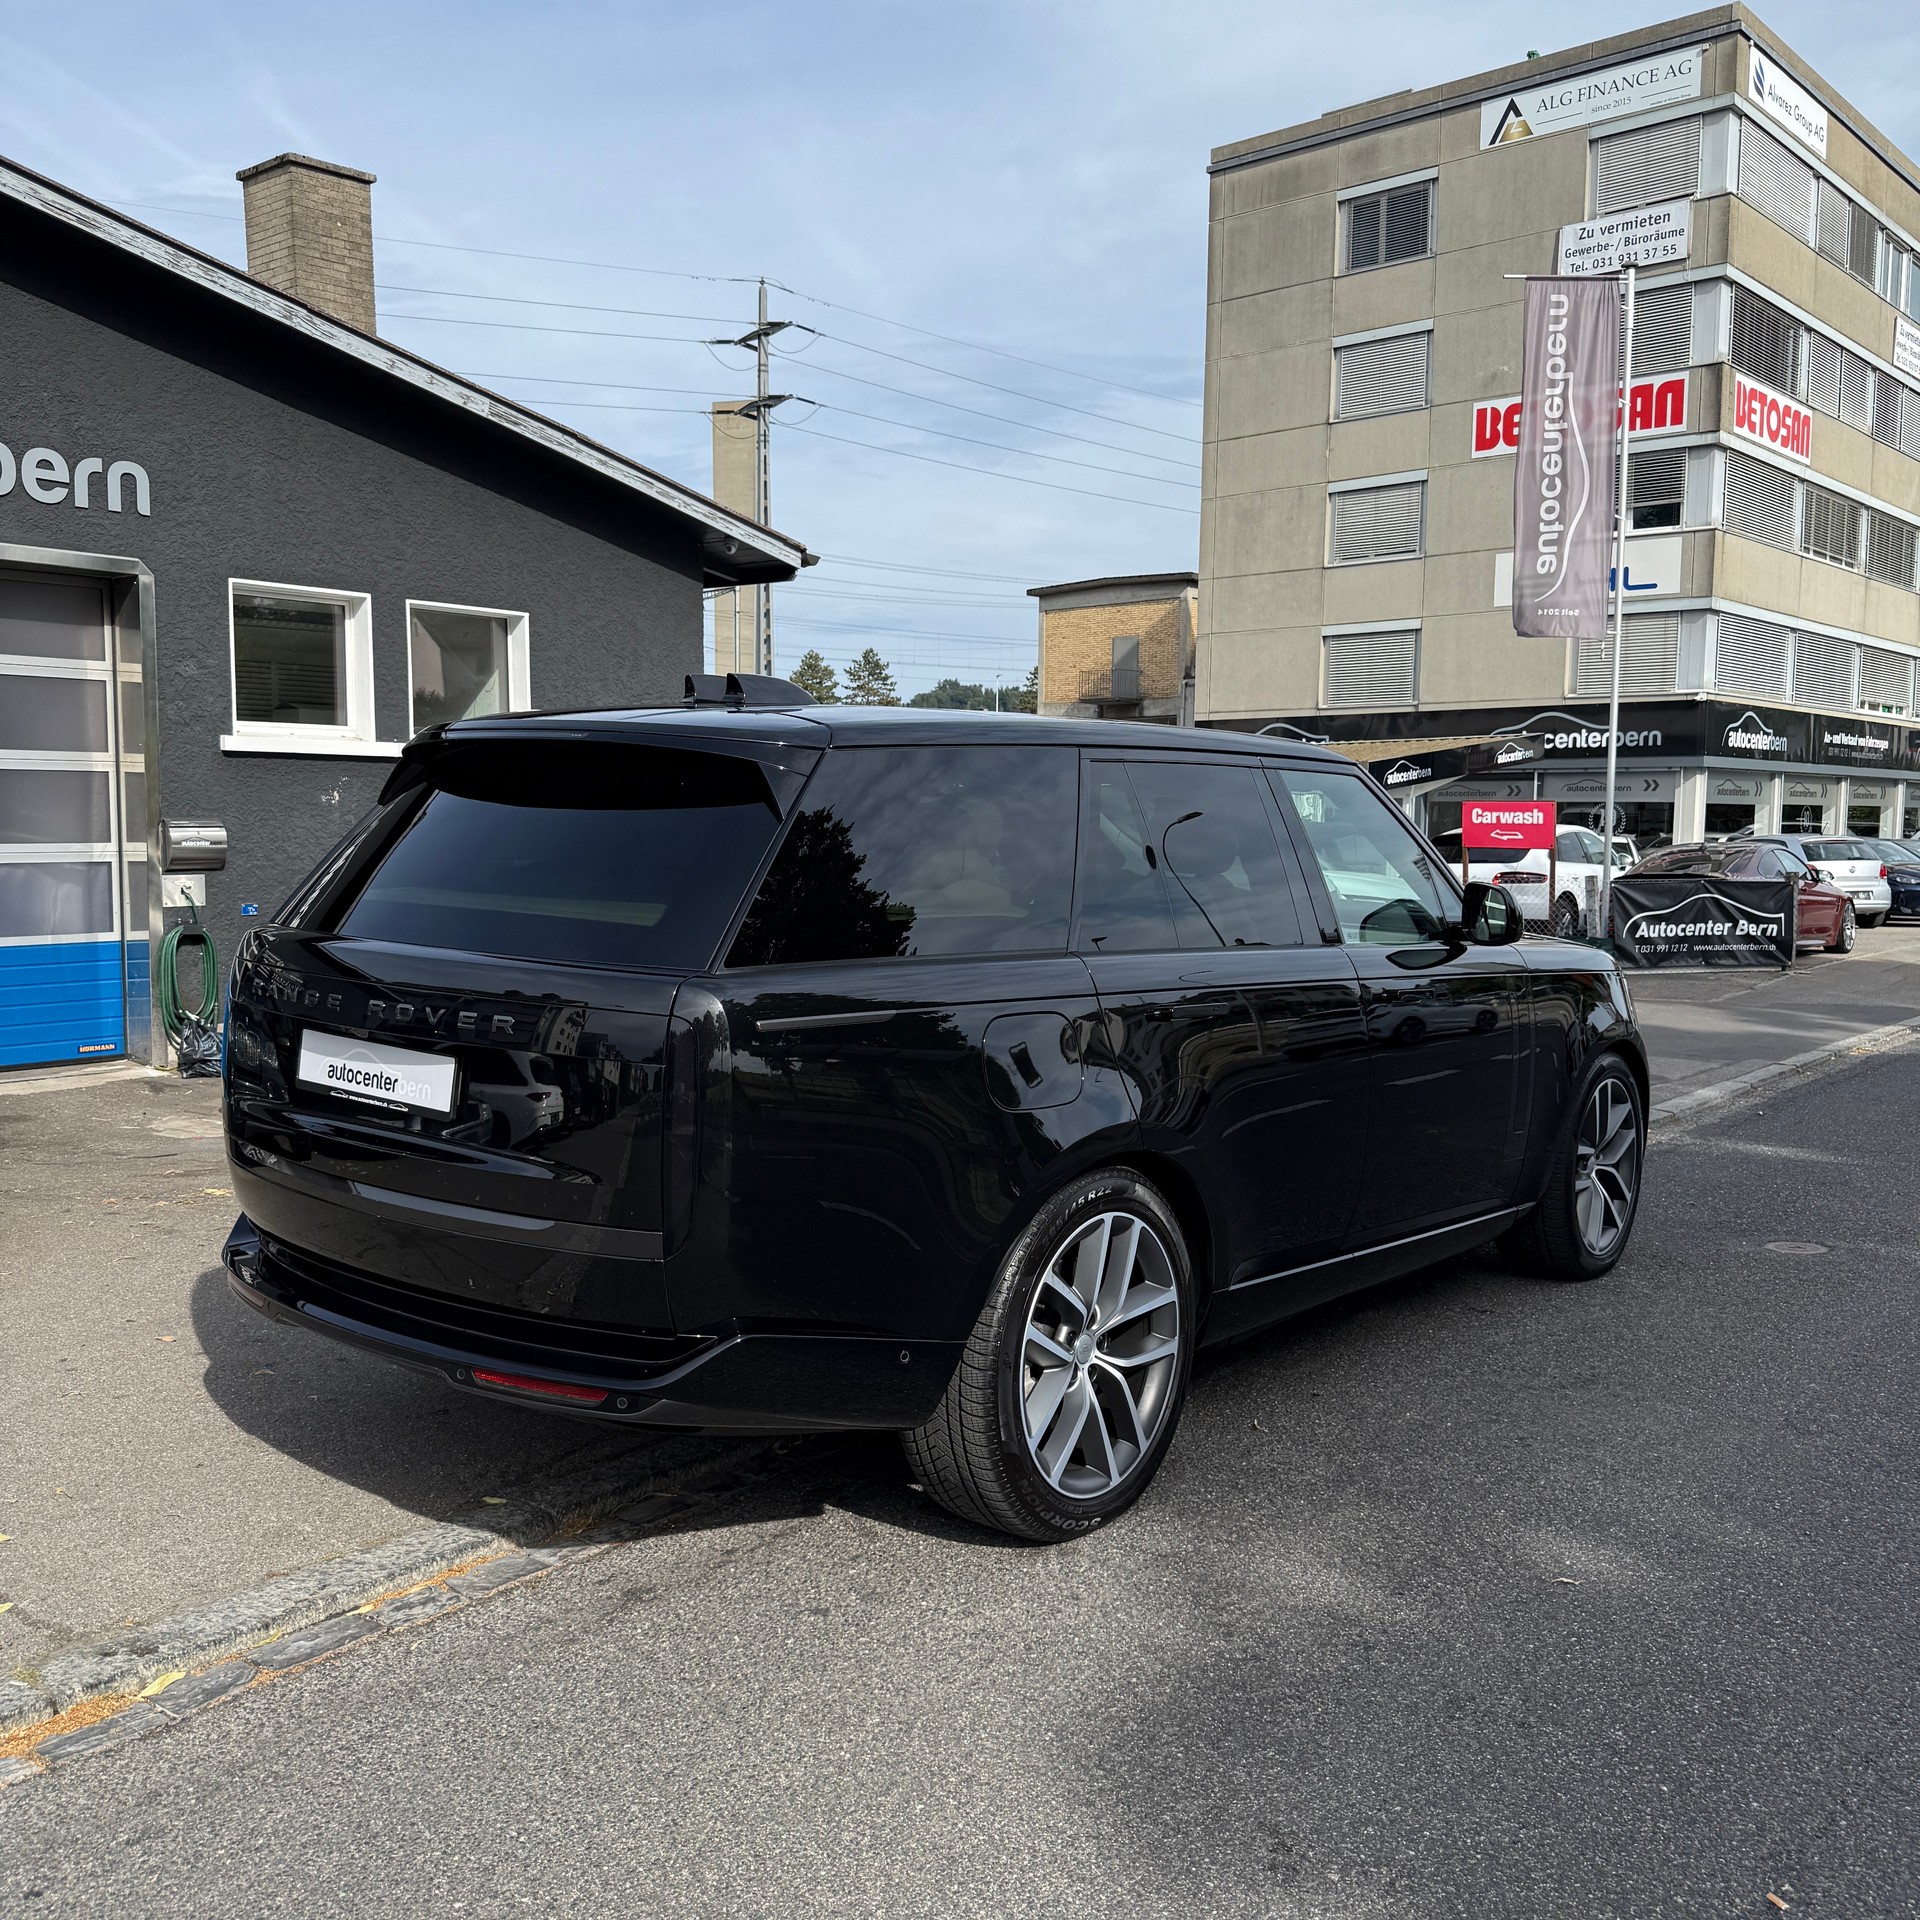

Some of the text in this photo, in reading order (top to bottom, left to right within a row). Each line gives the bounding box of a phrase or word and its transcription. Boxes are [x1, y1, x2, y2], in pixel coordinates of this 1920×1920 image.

[1536, 59, 1692, 113] ALG FINANCE AG
[1591, 96, 1632, 114] since 2015
[1767, 83, 1825, 142] Alvarez Group AG
[1578, 212, 1671, 241] Zu vermieten
[1624, 228, 1685, 247] Büroräume
[1570, 243, 1677, 273] Tel. 031 931 37 55
[1474, 378, 1686, 452] BEAN
[1735, 379, 1812, 459] BETOSAN
[1728, 729, 1788, 752] autocenterbern
[1387, 768, 1432, 785] autocenterbern
[1437, 788, 1497, 797] autocenterbern
[1566, 784, 1632, 793] autocenteern
[1471, 808, 1544, 825] Carwash
[1634, 919, 1779, 939] Autocenter Bern
[1634, 945, 1641, 953] T
[1640, 945, 1654, 953] 031
[1656, 944, 1669, 953] 991
[1693, 943, 1777, 952] www.autocenterbern.ch
[251, 978, 343, 1012] RANGE
[366, 999, 516, 1035] ROVER
[327, 1062, 432, 1101] autocenterbern
[1087, 1185, 1113, 1202] R22
